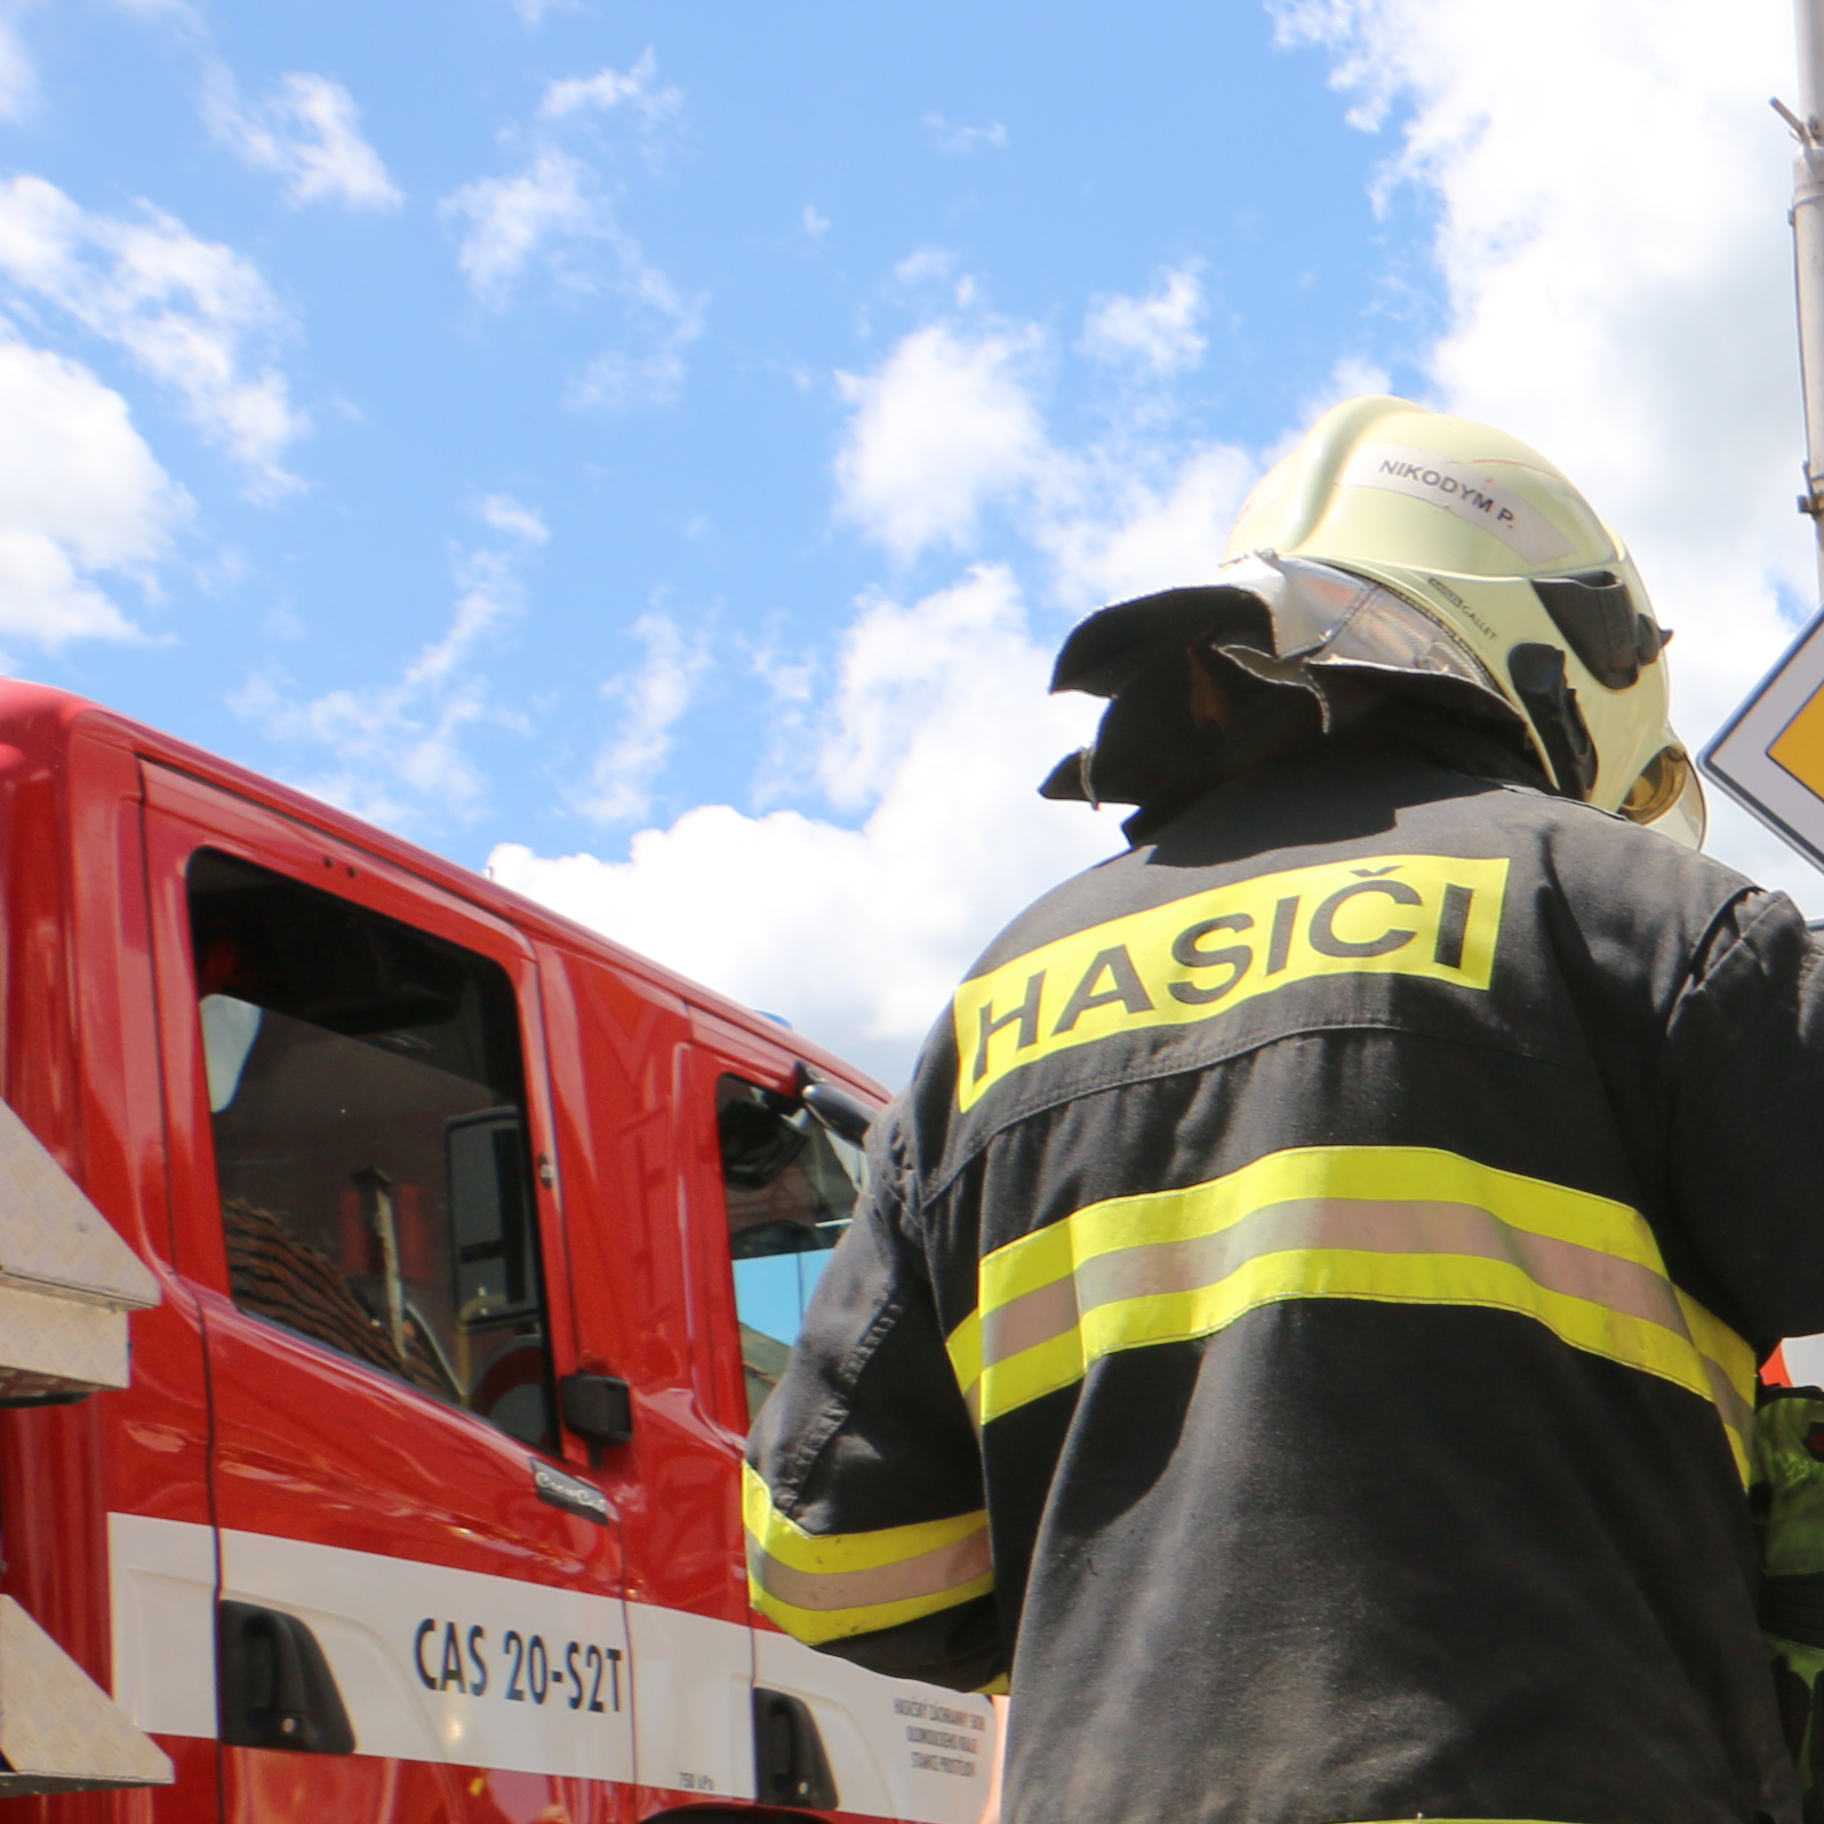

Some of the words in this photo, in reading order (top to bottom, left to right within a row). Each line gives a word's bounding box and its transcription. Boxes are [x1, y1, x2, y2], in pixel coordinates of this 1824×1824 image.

[1378, 459, 1494, 513] NIKODYM
[972, 865, 1474, 1086] HASIČI
[413, 1617, 487, 1697] CAS
[503, 1630, 622, 1713] 20-S2T
